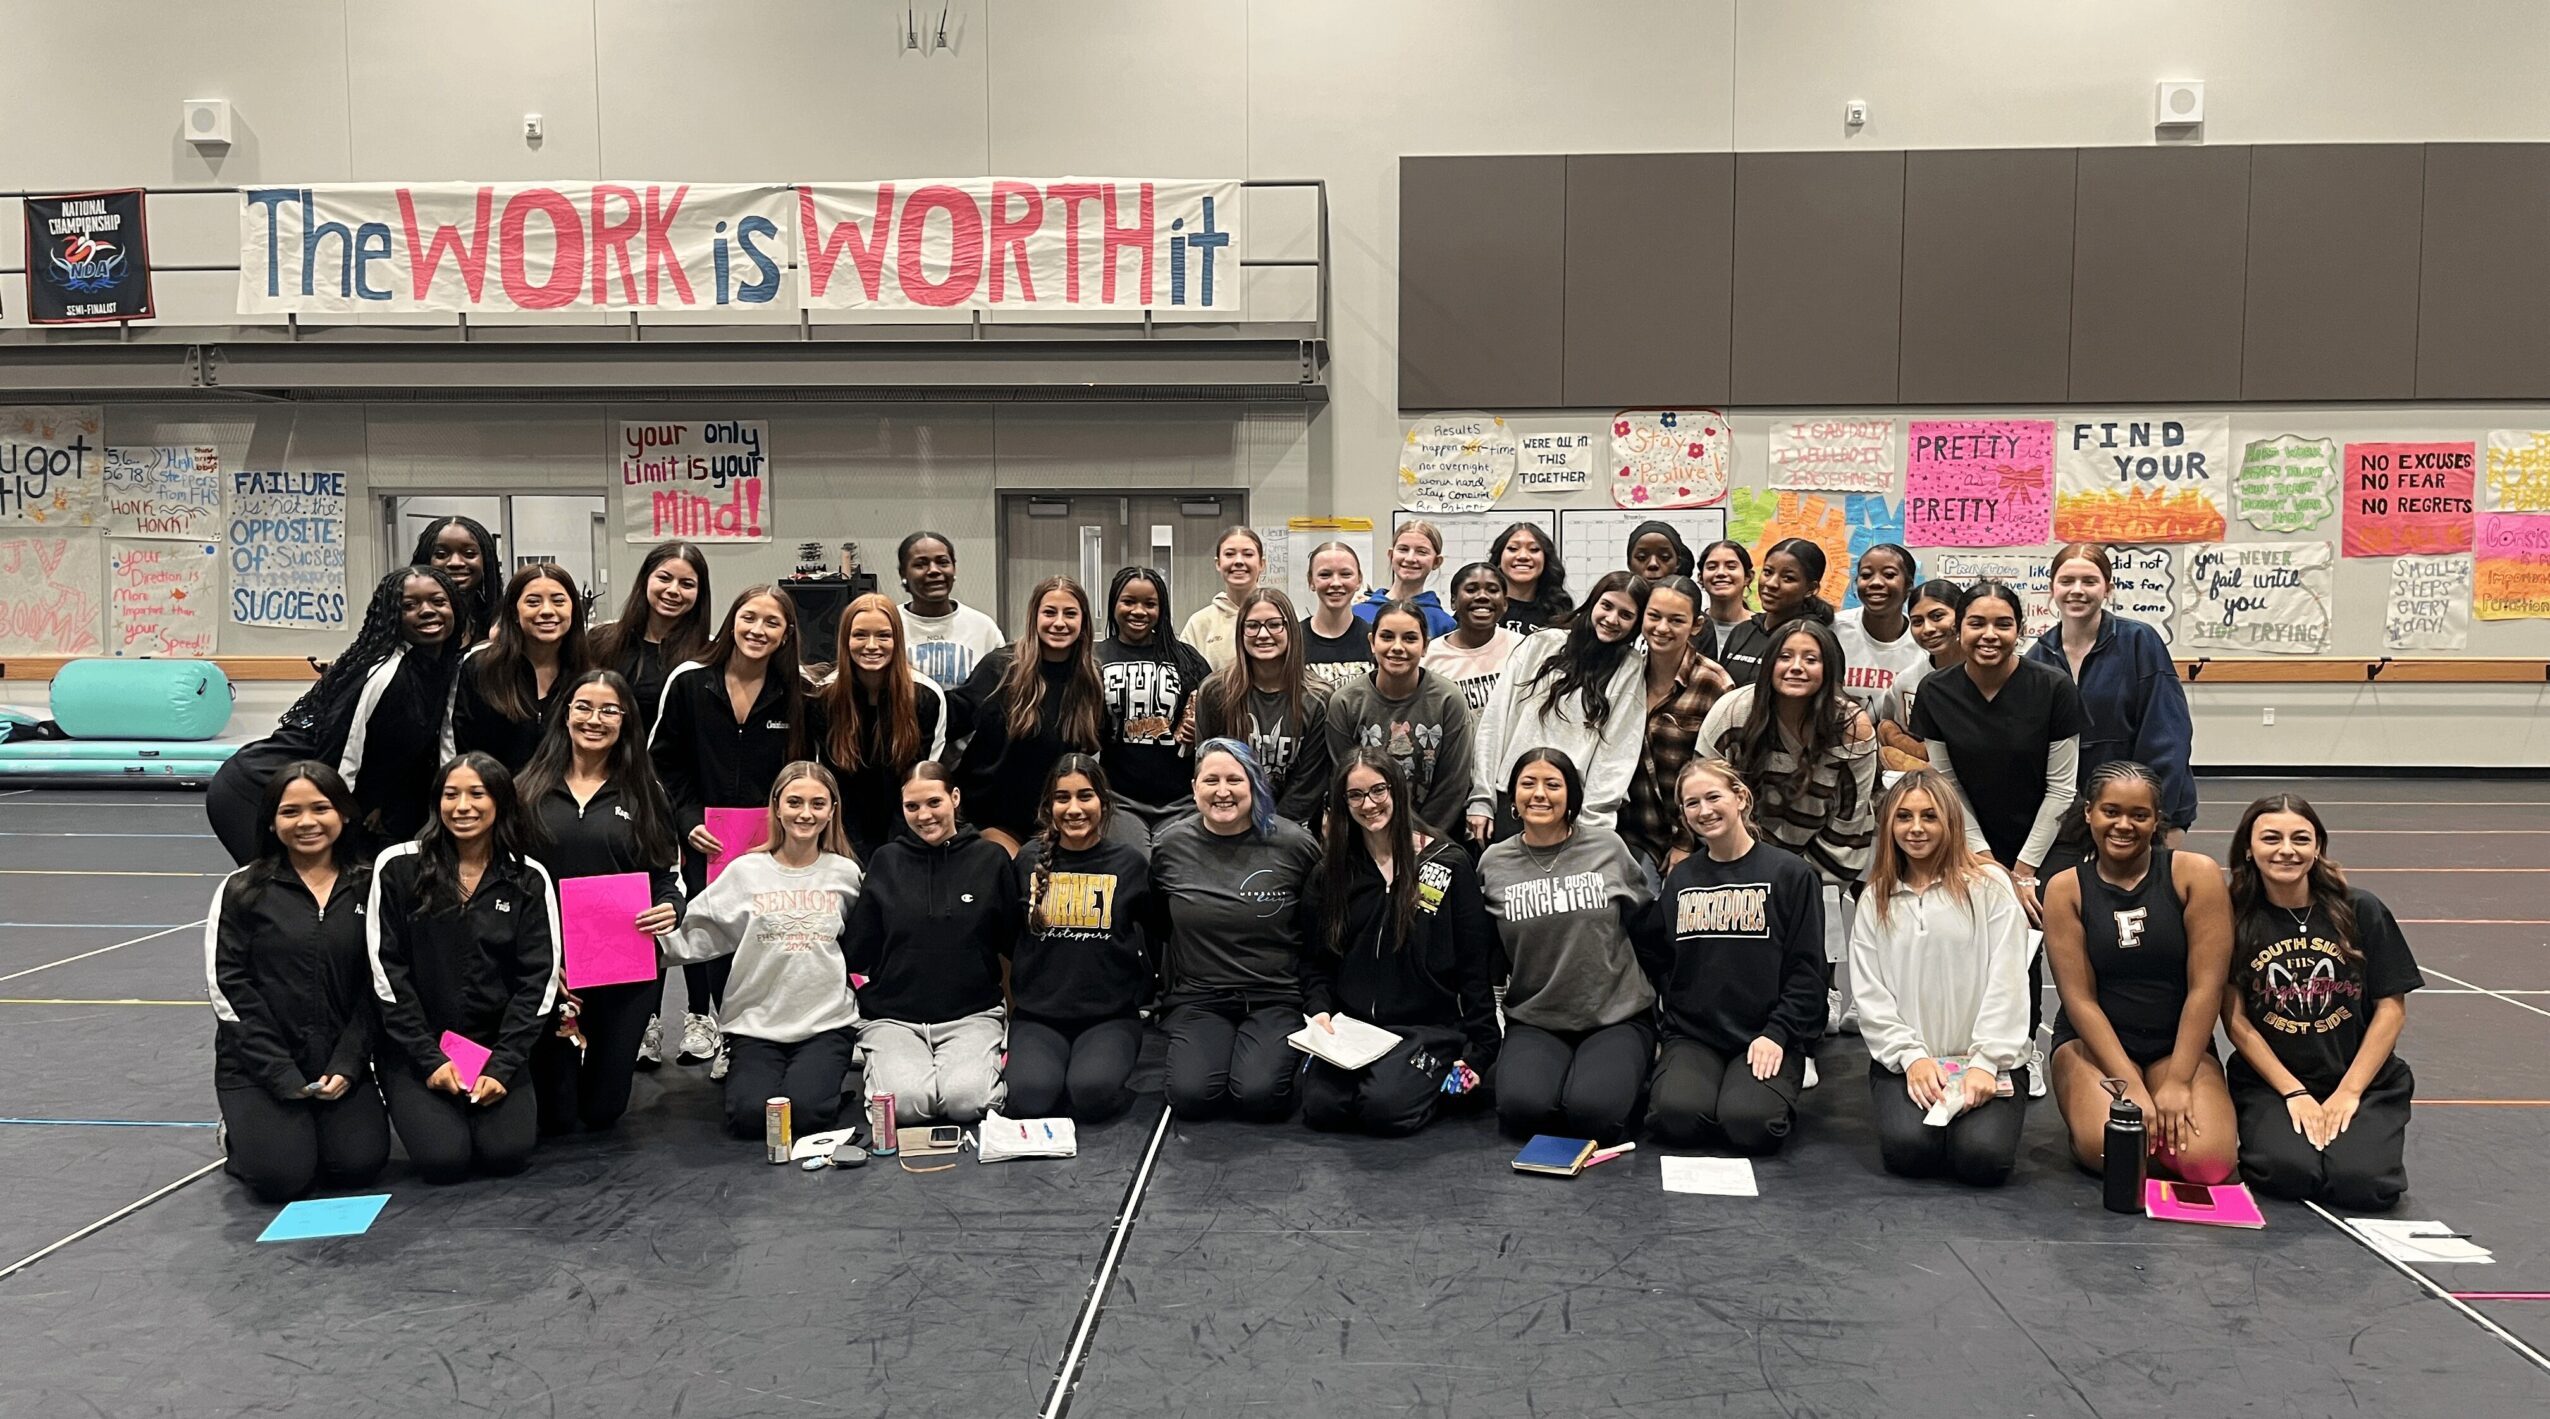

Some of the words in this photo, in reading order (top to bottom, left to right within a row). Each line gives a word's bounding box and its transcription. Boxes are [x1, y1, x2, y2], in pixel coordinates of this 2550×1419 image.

[61, 199, 107, 217] NATIONAL
[48, 214, 121, 235] CHAMPIONSHIP
[248, 188, 392, 301] The
[394, 184, 696, 310] WORK
[713, 215, 779, 305] is
[798, 180, 1153, 307] WORTH
[1171, 197, 1229, 306] it
[69, 259, 110, 279] NDA
[66, 302, 117, 316] SEMI-FINALIST
[626, 424, 688, 459] your
[704, 421, 760, 456] only
[1523, 438, 1551, 449] WERE
[1625, 426, 1686, 464] Stay
[1917, 436, 2020, 462] PRETTY
[2074, 422, 2185, 450] FIND
[687, 454, 708, 480] is
[712, 454, 765, 489] your
[1538, 454, 1566, 465] THIS
[2114, 452, 2210, 482] YOUR
[2361, 455, 2389, 471] NO
[2399, 454, 2472, 469] EXCUSES
[234, 472, 346, 497] FAILURE
[1518, 471, 1587, 485] TOGETHER
[2361, 473, 2389, 490] NO
[2398, 474, 2446, 489] FEAR
[652, 478, 763, 538] Mind!
[1913, 498, 1999, 523] PRETTY
[2361, 498, 2388, 515] NO
[2398, 497, 2472, 514] REGRETS
[230, 516, 338, 546] OPPOSITE
[2112, 553, 2132, 570] did
[2140, 553, 2164, 570] not
[2239, 551, 2292, 566] NEVER
[2140, 578, 2165, 592] far
[2254, 567, 2302, 589] until
[234, 588, 345, 623] SUCCESS
[2132, 603, 2166, 613] come
[2223, 596, 2268, 627] you
[1418, 863, 1453, 894] DREAM
[1504, 877, 1551, 901] STEPHEN
[1564, 871, 1605, 891] AUSTIN
[751, 889, 838, 917] SENIOR
[1676, 888, 1767, 934] HIGHSTEPPERS
[2114, 906, 2148, 949] F
[2250, 937, 2308, 972] SOUTH
[2263, 1011, 2311, 1035] BEST
[2314, 1005, 2353, 1034] SIDE
